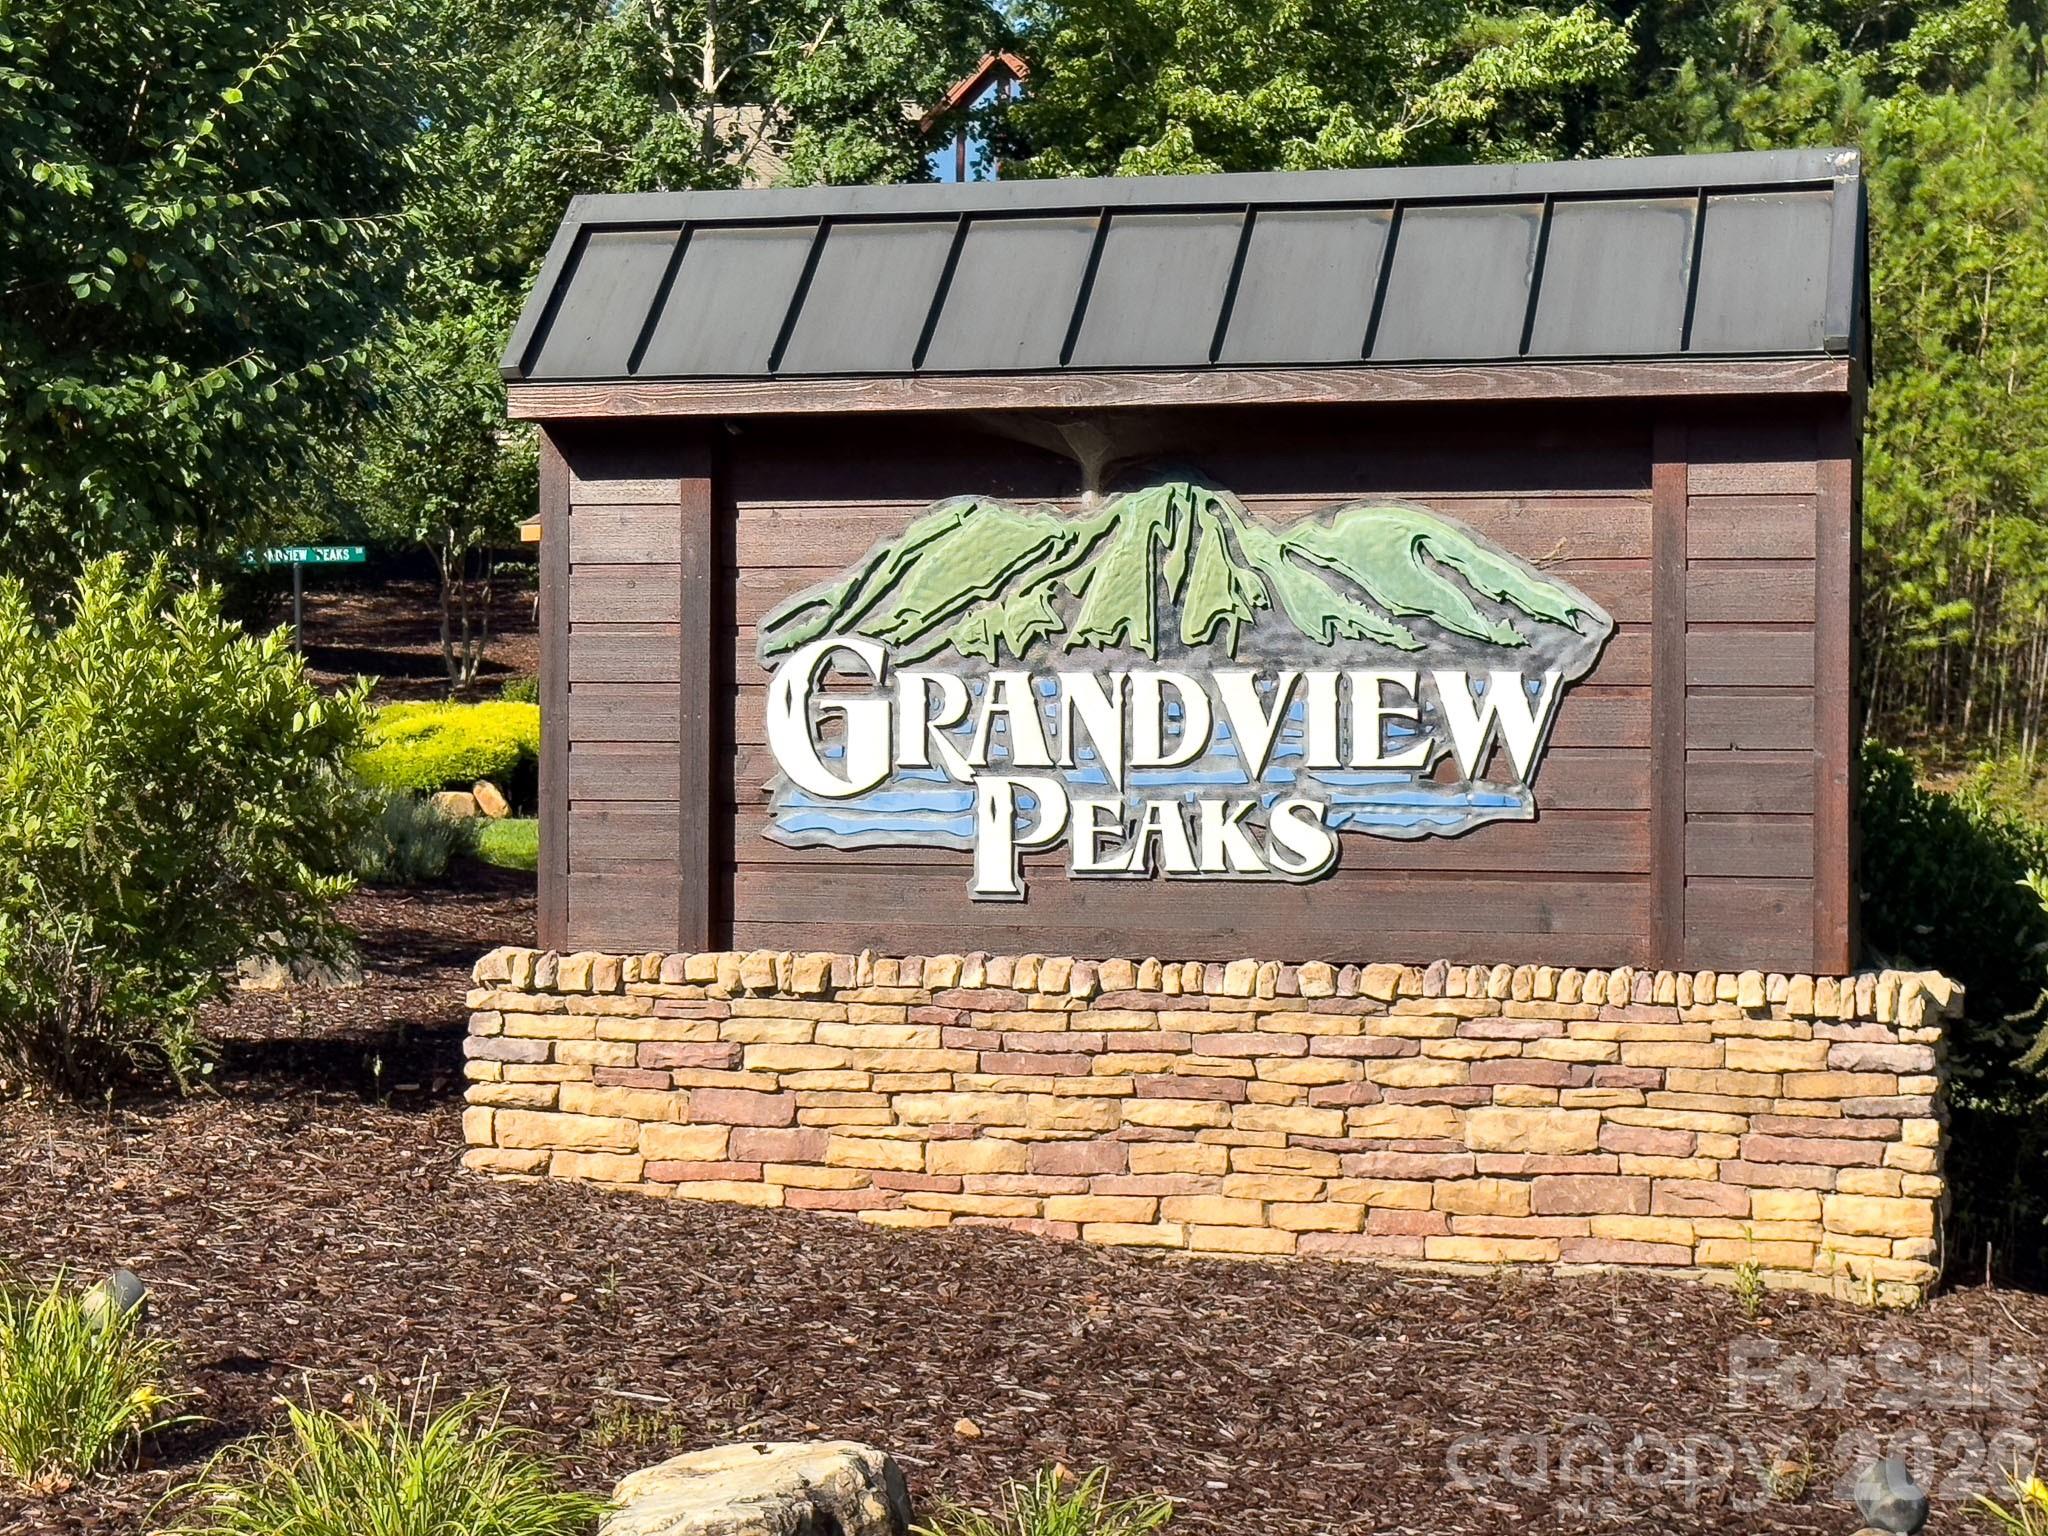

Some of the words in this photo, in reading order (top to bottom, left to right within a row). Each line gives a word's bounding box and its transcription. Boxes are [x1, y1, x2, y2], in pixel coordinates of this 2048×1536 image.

[246, 550, 307, 561] GNDVIEW
[767, 637, 1563, 796] GRANDVIEW
[974, 775, 1332, 896] PEAKS
